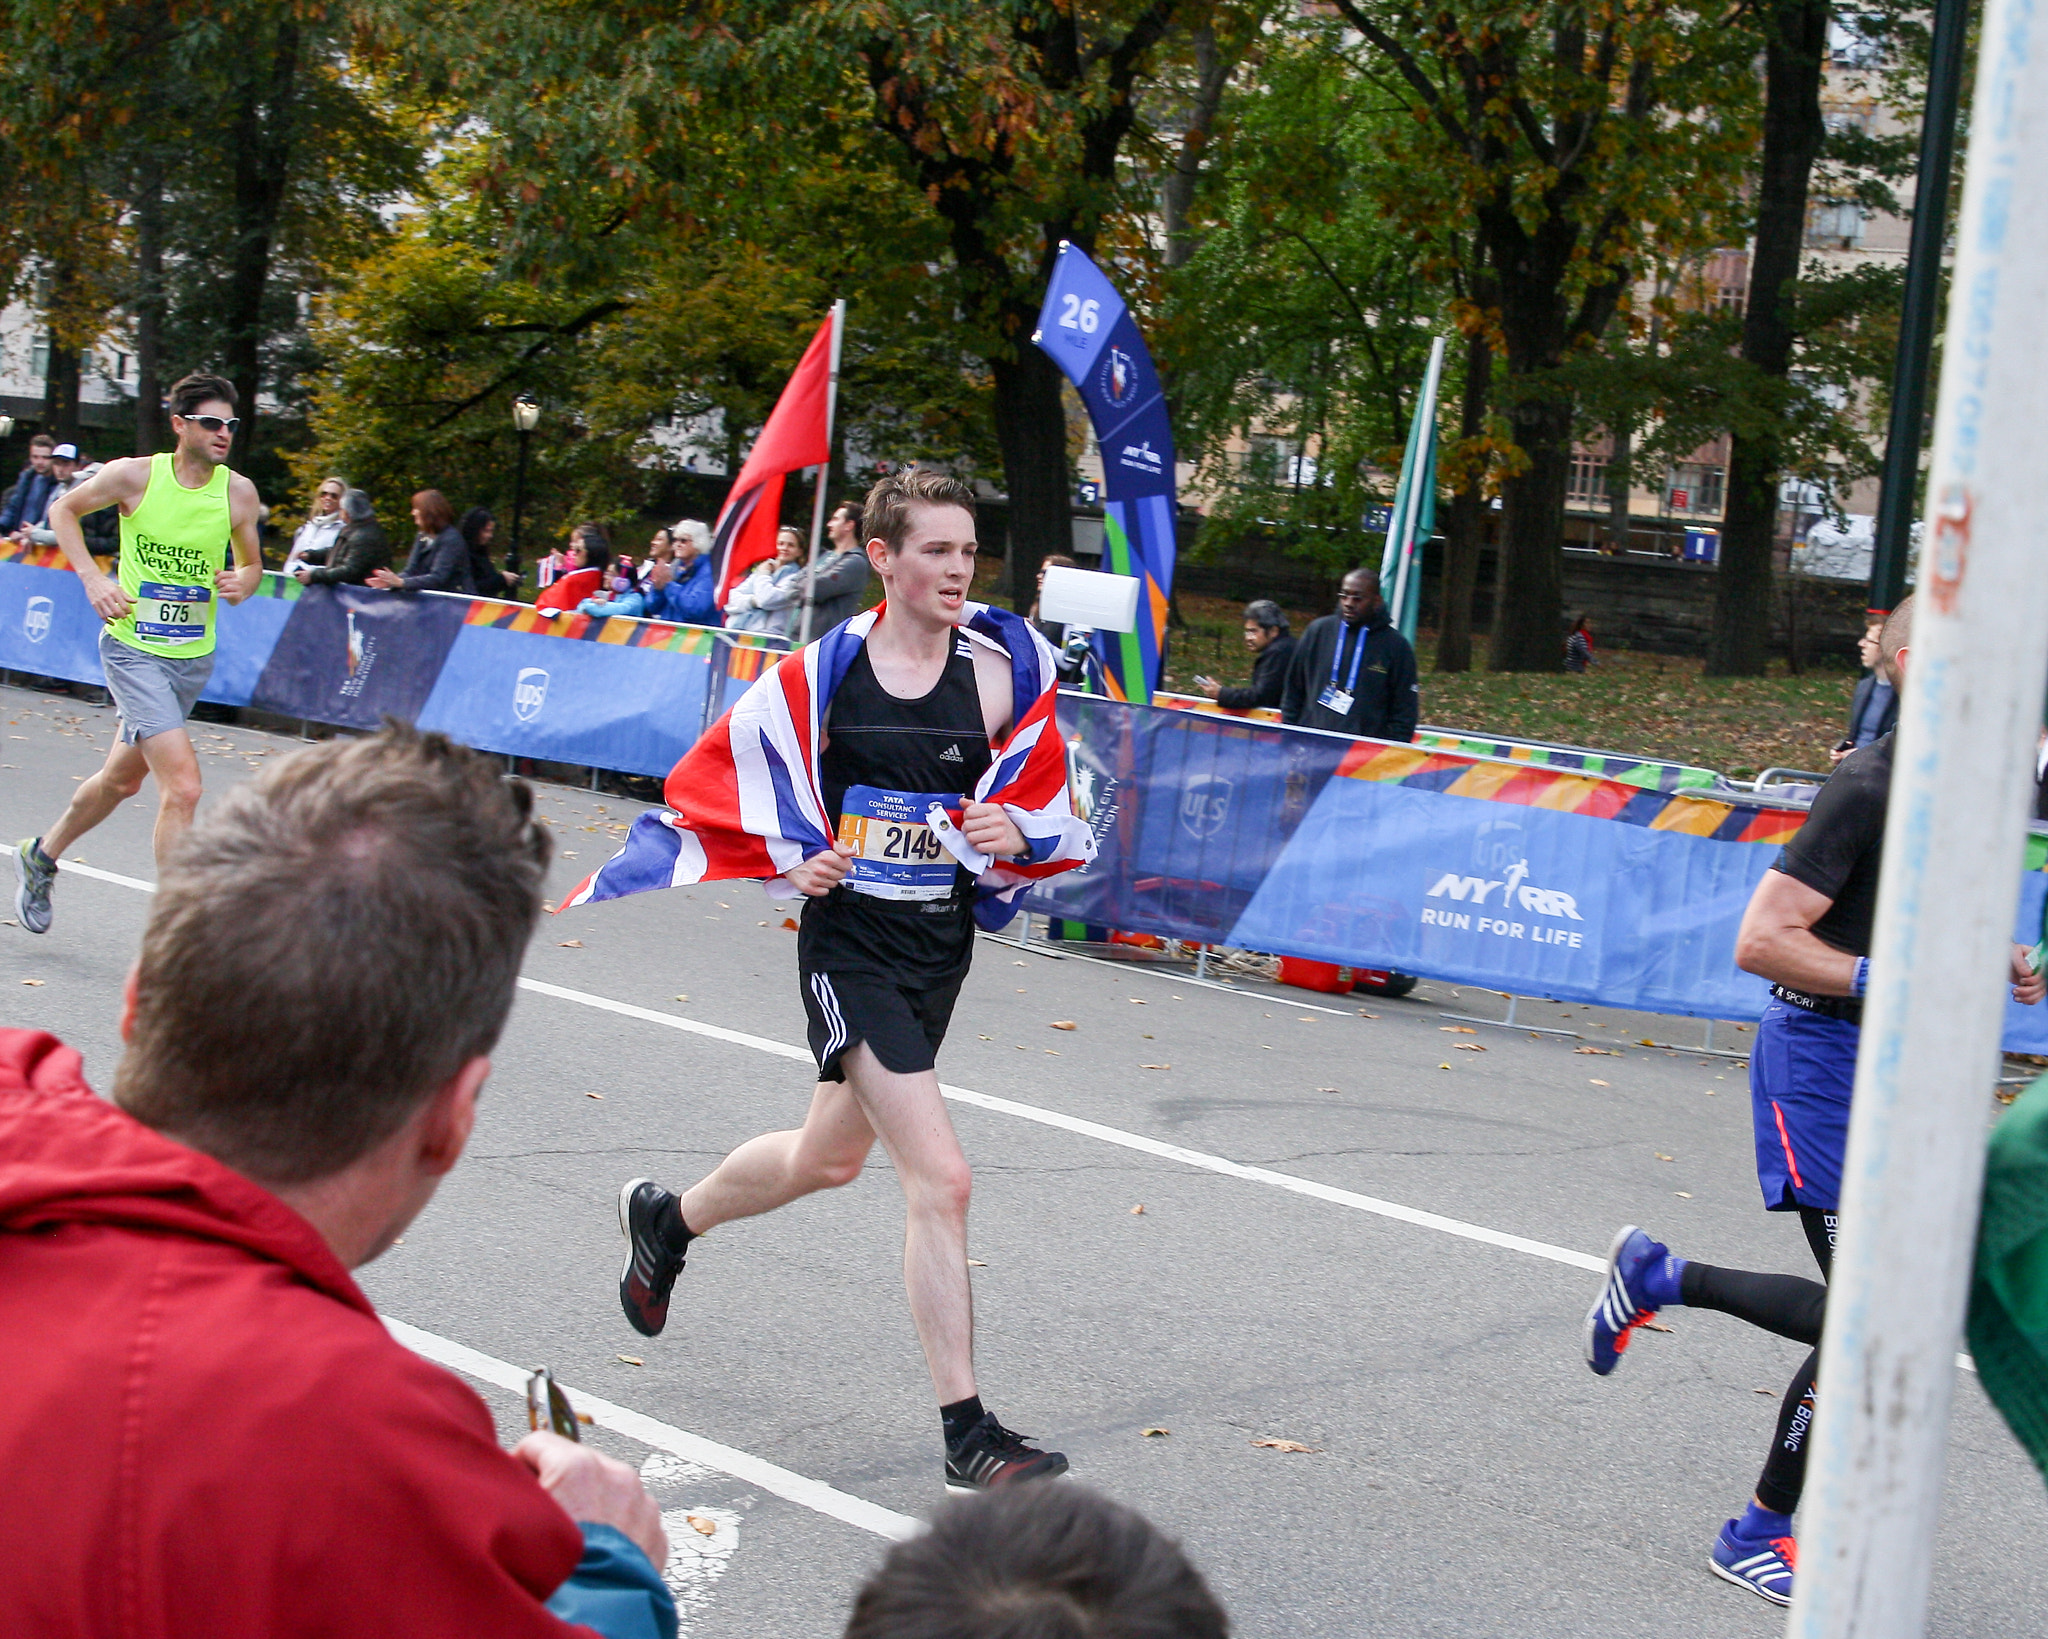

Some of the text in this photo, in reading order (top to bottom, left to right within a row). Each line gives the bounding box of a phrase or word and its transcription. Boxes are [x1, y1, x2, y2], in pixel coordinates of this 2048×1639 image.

[1059, 293, 1101, 334] 26
[137, 534, 203, 560] Greater
[135, 547, 210, 577] New York
[26, 610, 50, 636] ups
[161, 603, 189, 623] 675
[515, 684, 544, 712] ups
[939, 754, 964, 763] adidas
[868, 800, 917, 813] CONSULTANCY
[883, 796, 904, 804] TATA
[876, 809, 908, 820] SERVICES
[884, 827, 940, 859] 2149
[1421, 907, 1584, 949] RUN FOR LIFE
[1783, 1404, 1814, 1452] BIONIC
